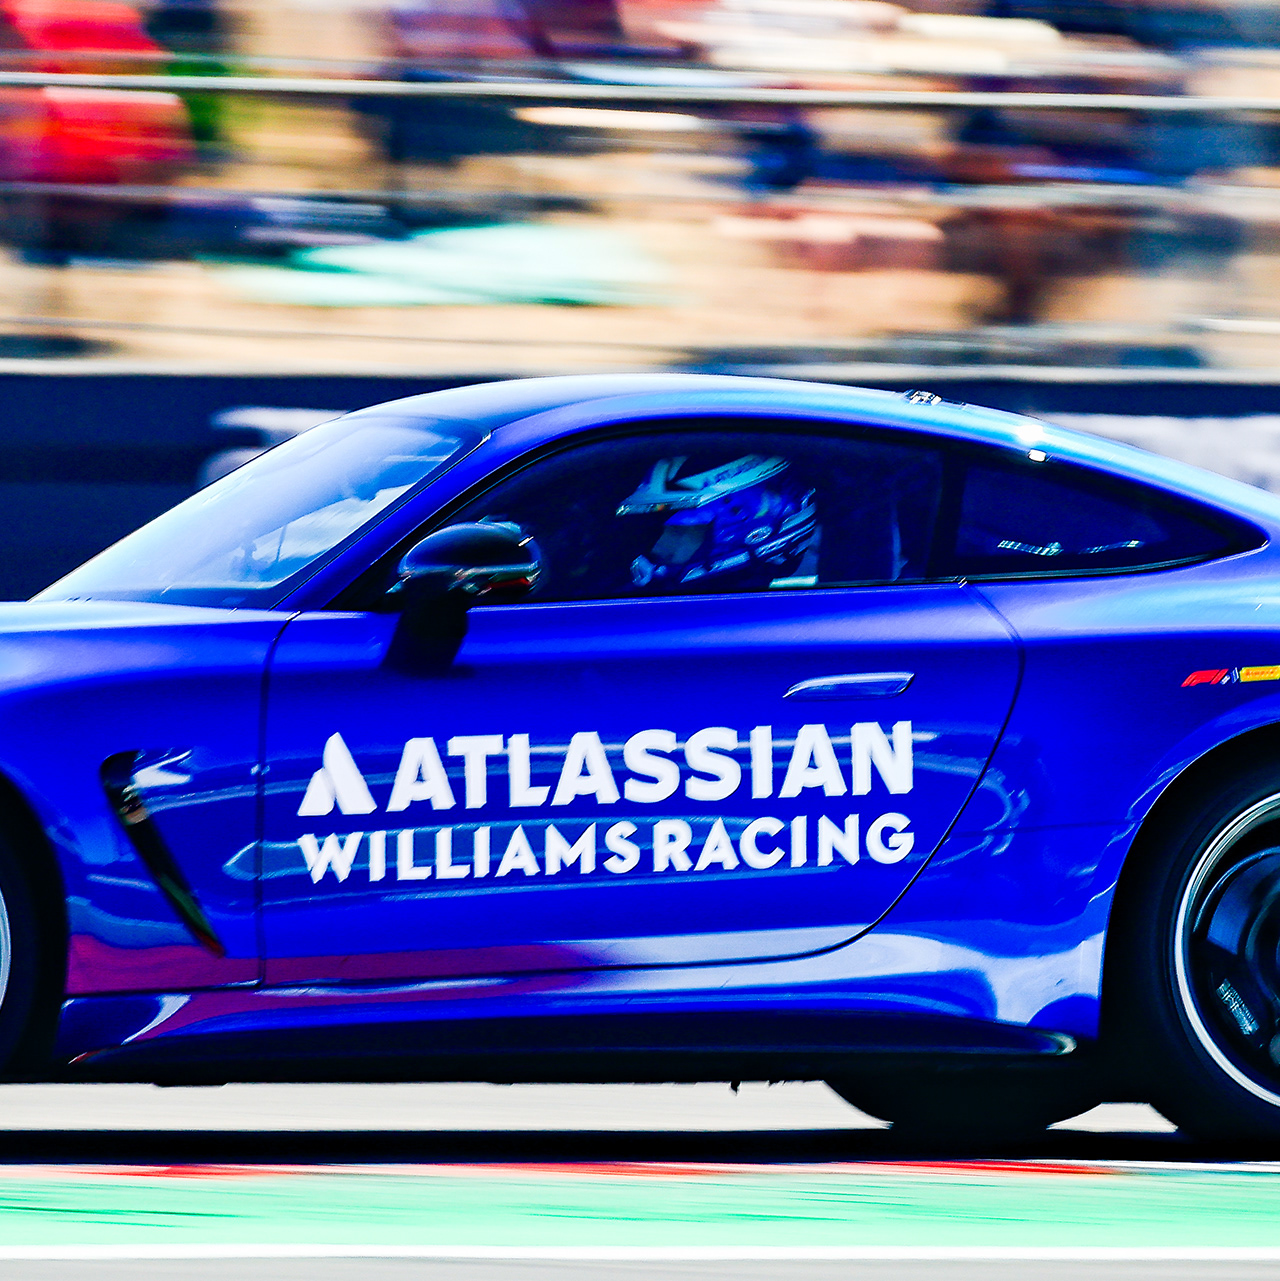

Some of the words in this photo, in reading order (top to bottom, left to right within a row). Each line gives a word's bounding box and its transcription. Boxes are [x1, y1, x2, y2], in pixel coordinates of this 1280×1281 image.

[386, 720, 915, 812] ATLASSIAN
[296, 819, 642, 885] WILLIAMS
[651, 812, 915, 873] RACING
